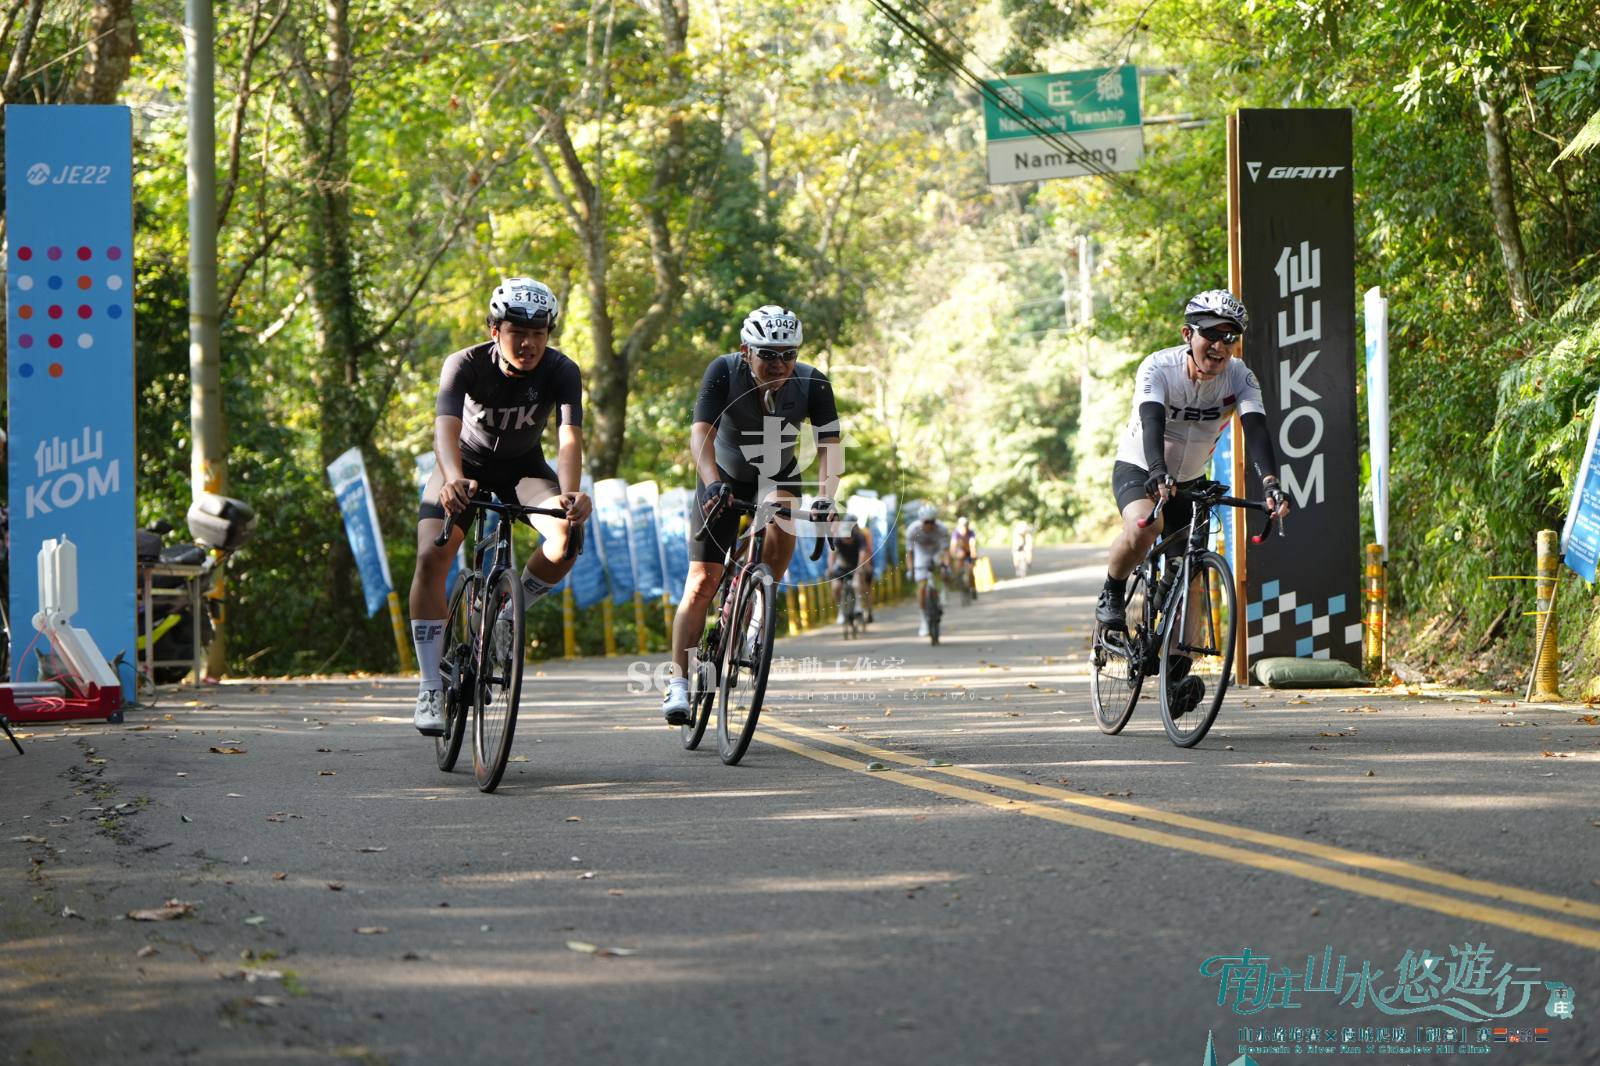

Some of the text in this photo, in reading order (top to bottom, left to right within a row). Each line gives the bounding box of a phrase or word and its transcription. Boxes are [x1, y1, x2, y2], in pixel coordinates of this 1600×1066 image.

[1070, 108, 1126, 126] Township
[52, 165, 111, 184] JE22
[1267, 166, 1345, 179] GIANT
[1274, 240, 1326, 508] 仙山 KOM
[34, 426, 103, 478] 仙山
[25, 459, 121, 519] KOM
[415, 625, 441, 641] EF
